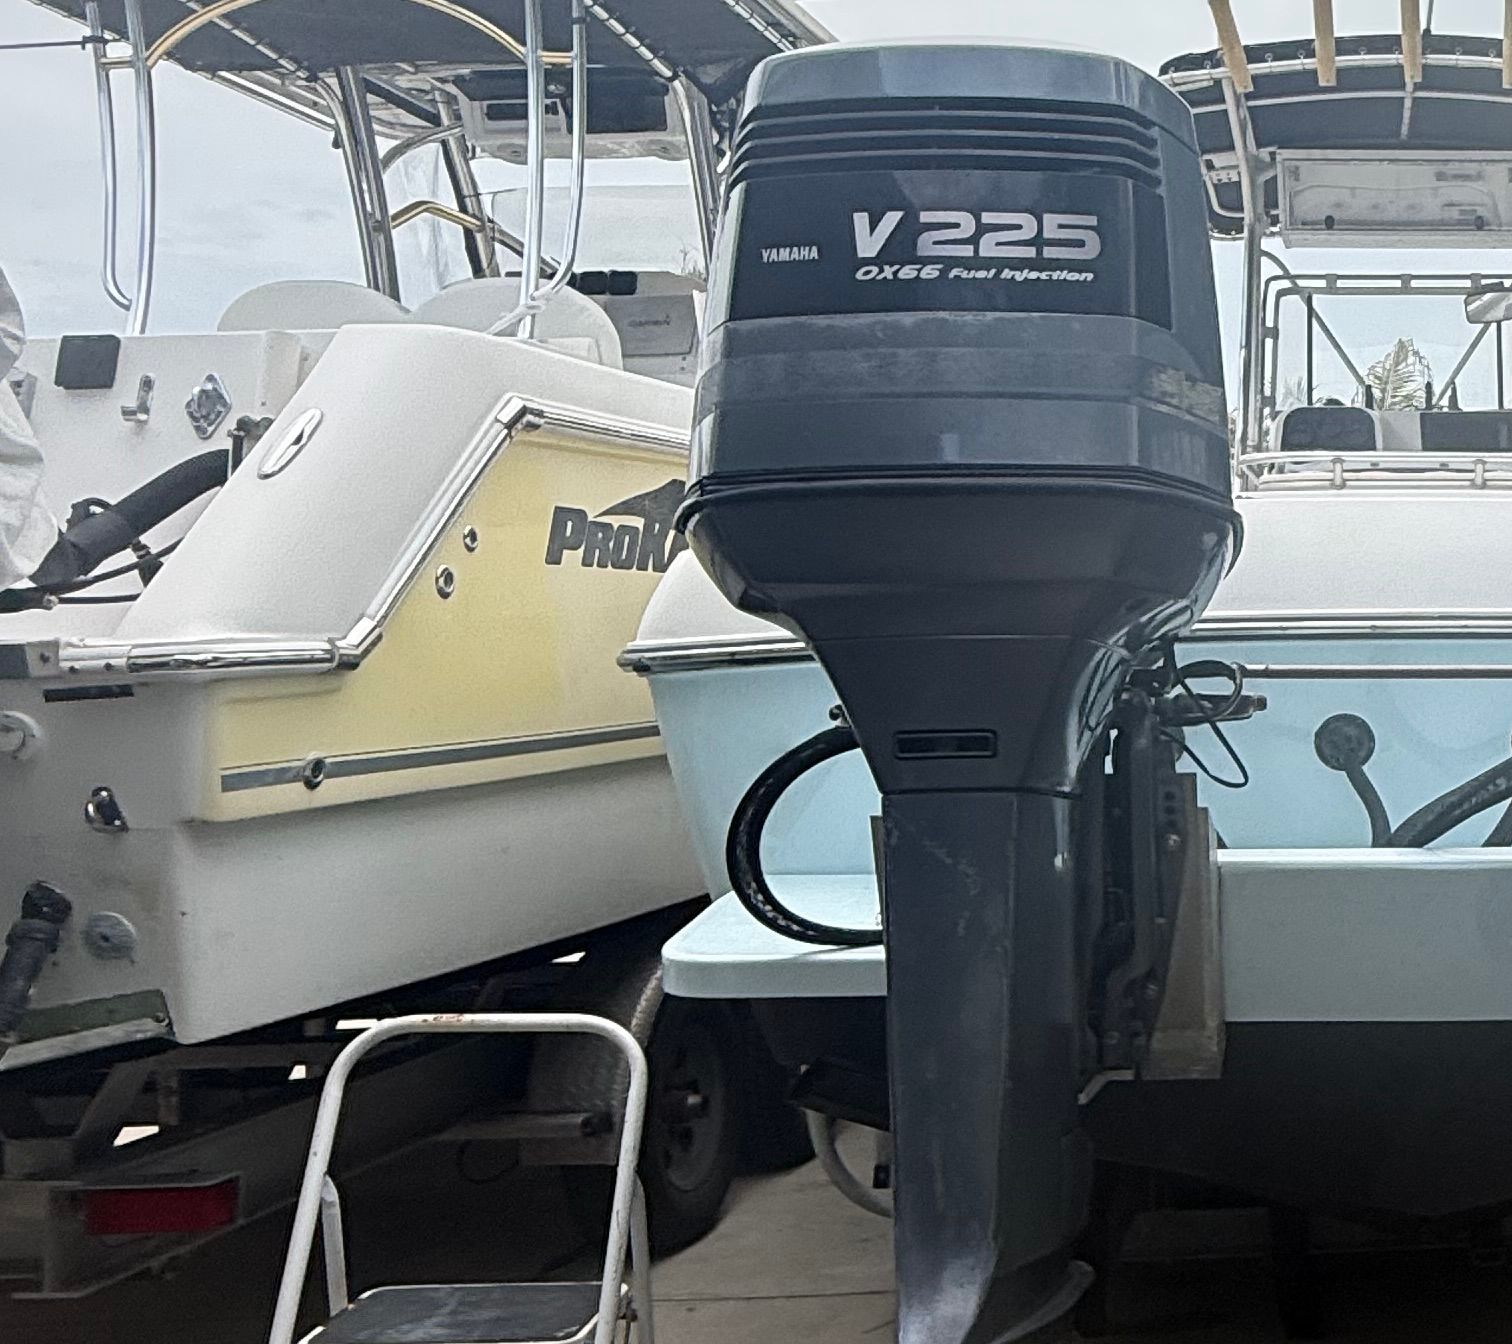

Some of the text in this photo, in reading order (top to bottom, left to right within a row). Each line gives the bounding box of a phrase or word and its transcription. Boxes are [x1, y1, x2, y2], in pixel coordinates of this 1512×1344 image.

[852, 210, 1101, 260] V 225
[761, 246, 819, 263] YAMAHA
[855, 264, 1095, 282] OX66 Fuel Injection
